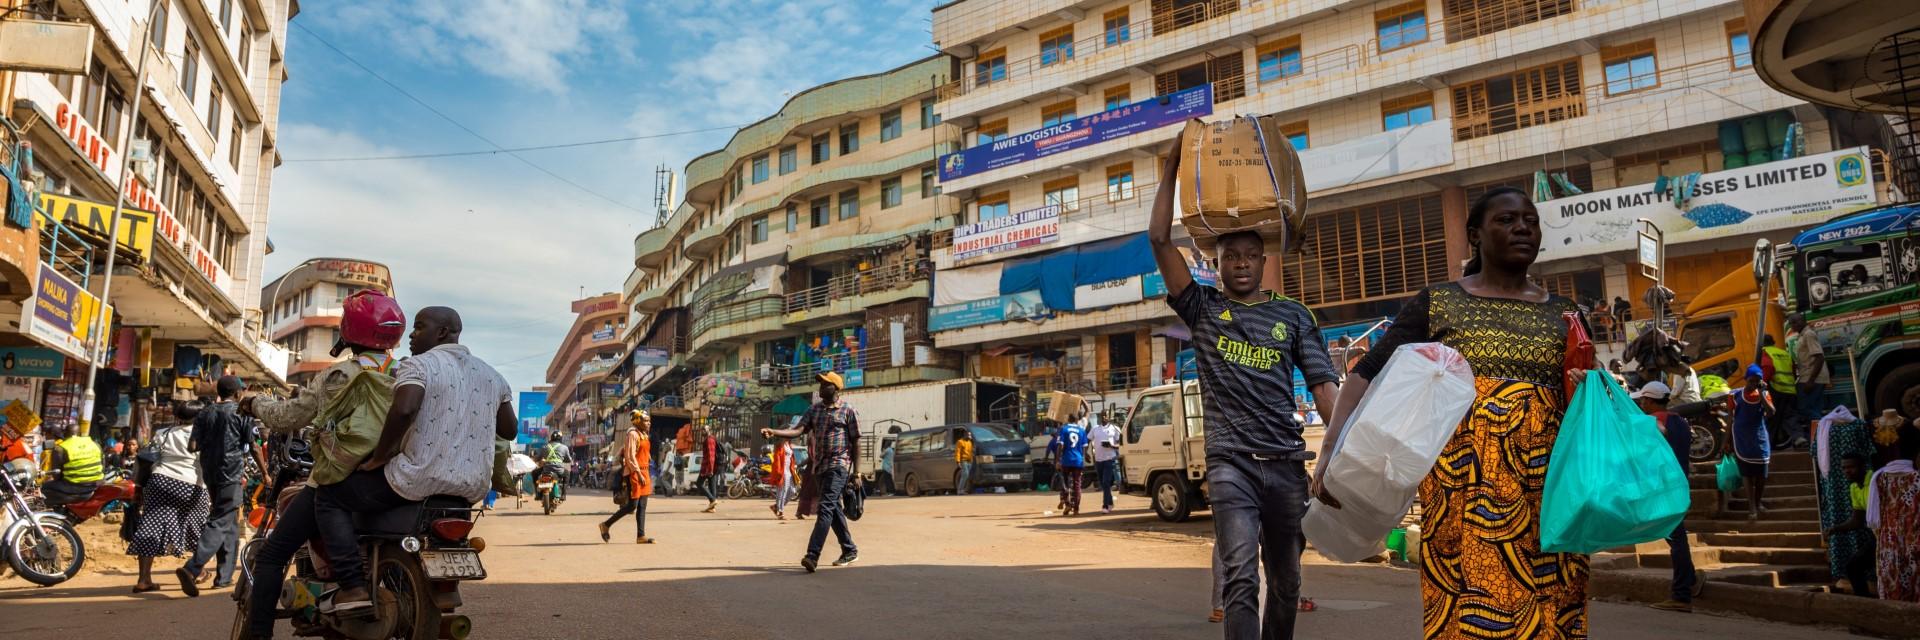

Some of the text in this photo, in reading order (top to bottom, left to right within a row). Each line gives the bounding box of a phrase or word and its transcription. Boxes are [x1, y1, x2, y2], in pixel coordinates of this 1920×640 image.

[56, 102, 110, 172] GIANT
[993, 122, 1072, 152] AWIE LOGISTICS
[1056, 129, 1089, 143] GUANGZHOU
[1561, 162, 1827, 219] MOON MATTRSSES LIMITED
[1770, 200, 1830, 213] ENVIRONMENTAL
[1832, 195, 1868, 204] FRIENDLY
[1792, 205, 1832, 215] MATERIALS
[39, 198, 148, 248] IANT
[954, 206, 1058, 238] DIPO TRADERS LIMITED
[1818, 225, 1872, 241] NEW 2022
[954, 235, 1003, 253] INDUSTRIAL
[1007, 223, 1058, 242] CHEMICALS
[43, 278, 68, 305] MALIKA
[1216, 335, 1282, 363] Emirates
[19, 358, 55, 368] wave
[1224, 352, 1272, 370] FLY BETTER
[1069, 432, 1079, 448] 9
[442, 552, 468, 564] UER
